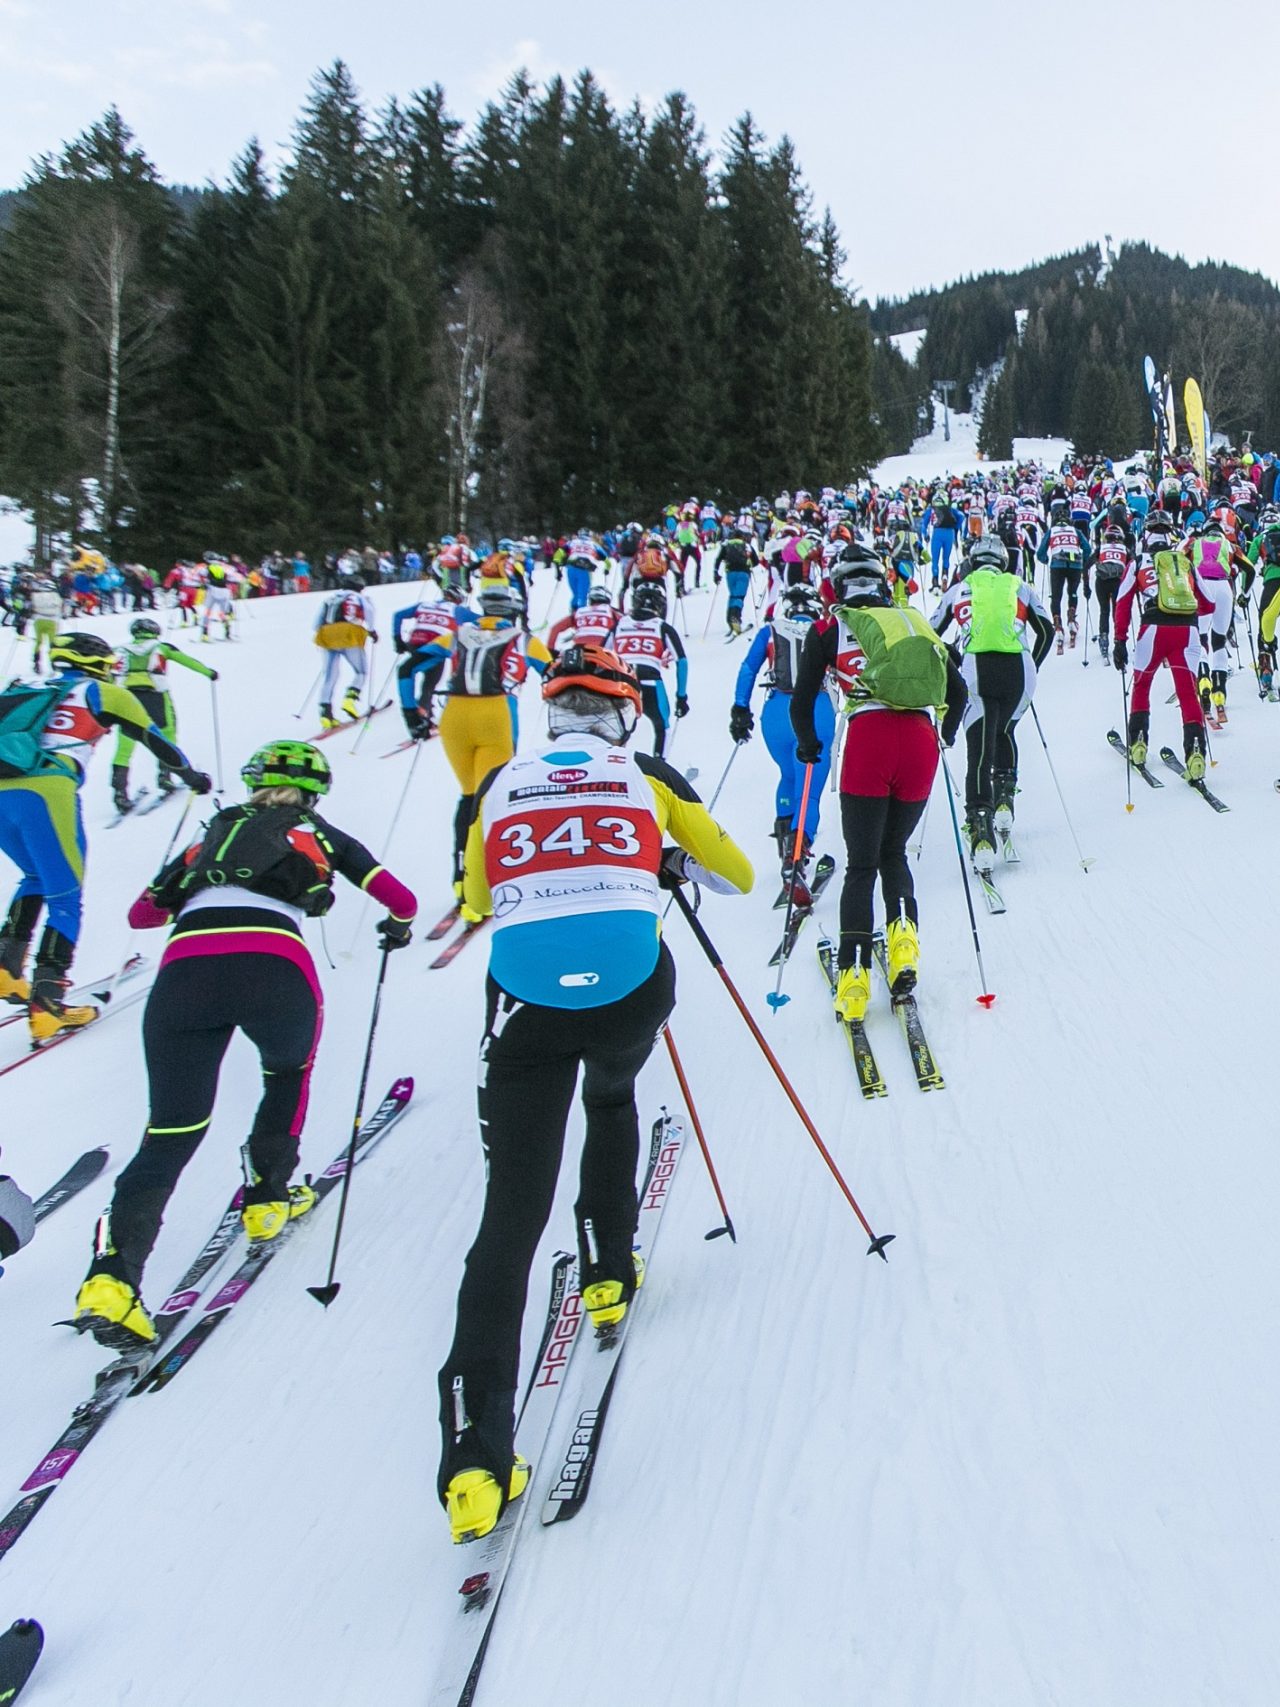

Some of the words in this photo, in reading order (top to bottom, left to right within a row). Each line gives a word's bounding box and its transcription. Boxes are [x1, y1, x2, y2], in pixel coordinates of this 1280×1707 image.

[1052, 536, 1079, 545] 428
[1105, 552, 1121, 560] 50
[615, 637, 657, 653] 735
[498, 815, 641, 868] 343
[202, 1210, 242, 1258] TRAB
[41, 1454, 74, 1472] 157
[548, 1409, 600, 1501] hagan
